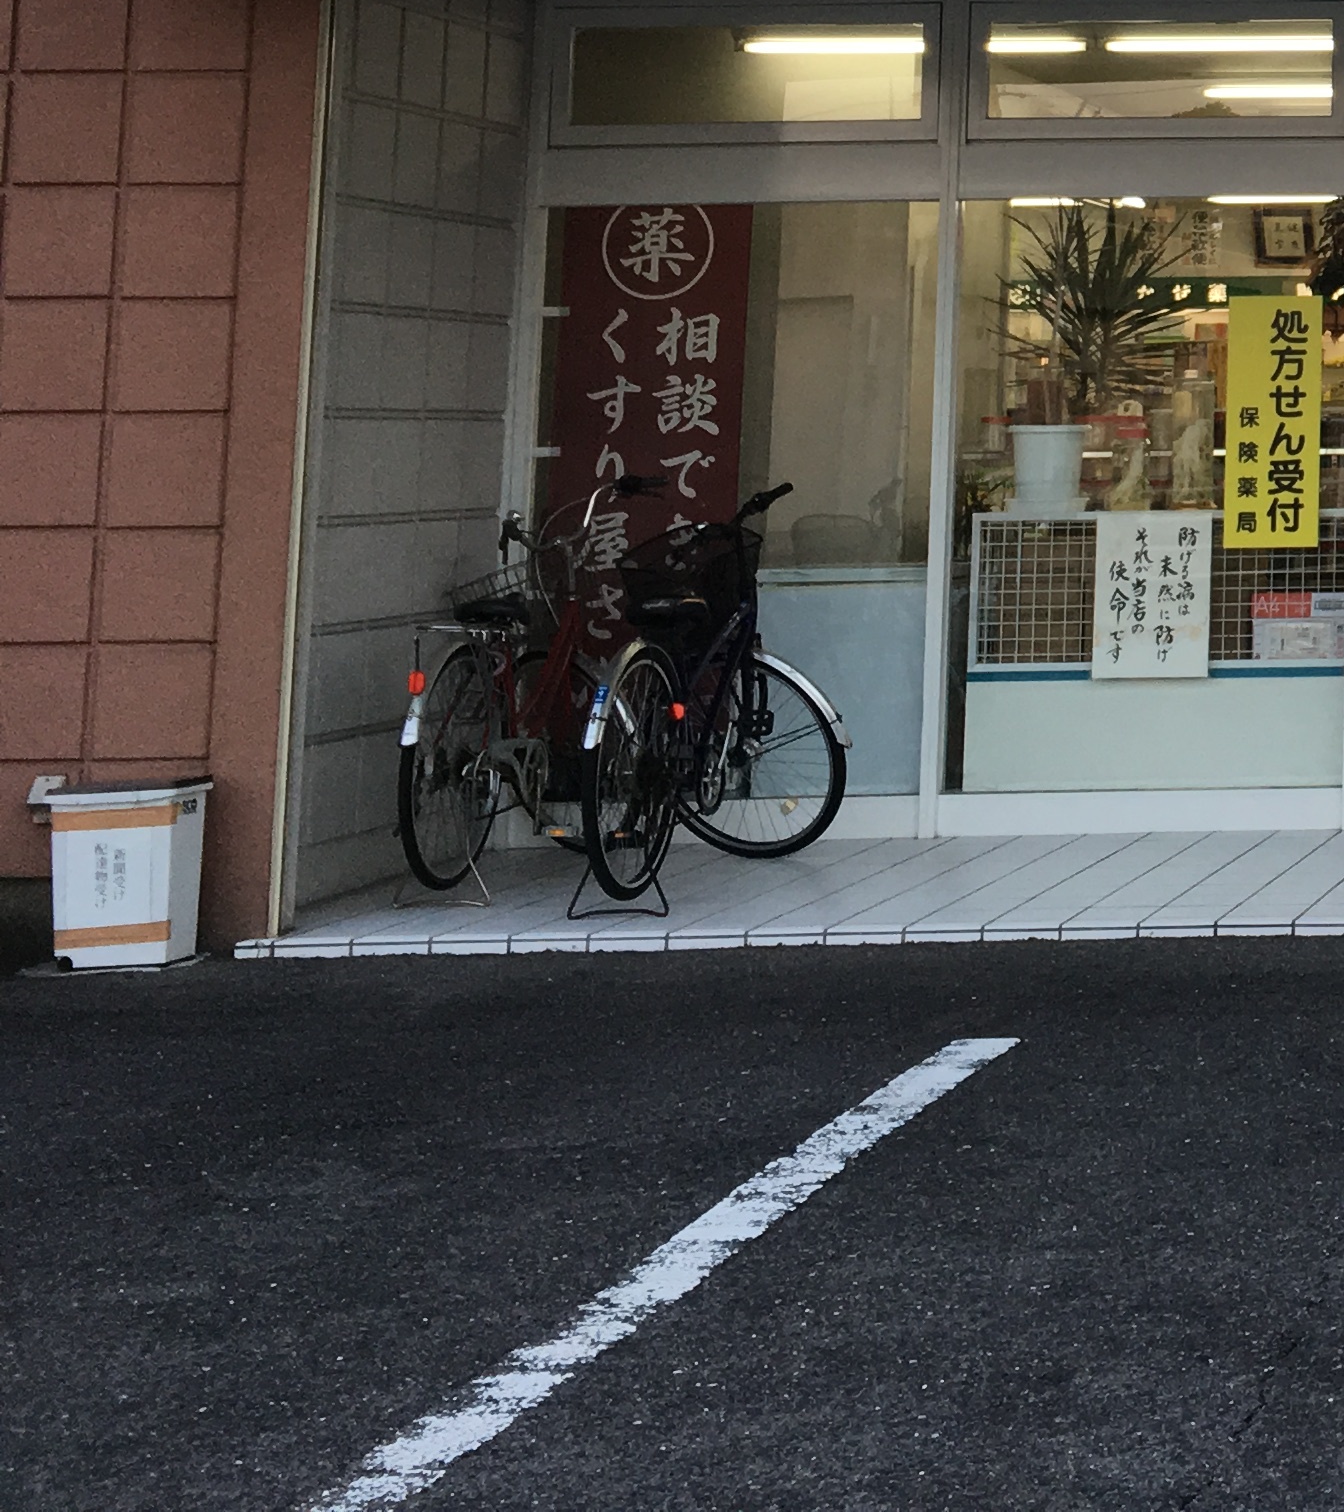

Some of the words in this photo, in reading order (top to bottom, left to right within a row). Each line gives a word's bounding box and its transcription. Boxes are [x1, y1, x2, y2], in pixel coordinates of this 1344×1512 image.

[619, 207, 695, 283] 薬
[1236, 406, 1260, 534] 保険薬局
[1267, 308, 1310, 534] 処方せん受付
[584, 308, 642, 668] くすり屋さ
[1106, 560, 1130, 664] 使命です
[1127, 527, 1154, 634] それが当店の
[1176, 527, 1200, 616] 防げる病は
